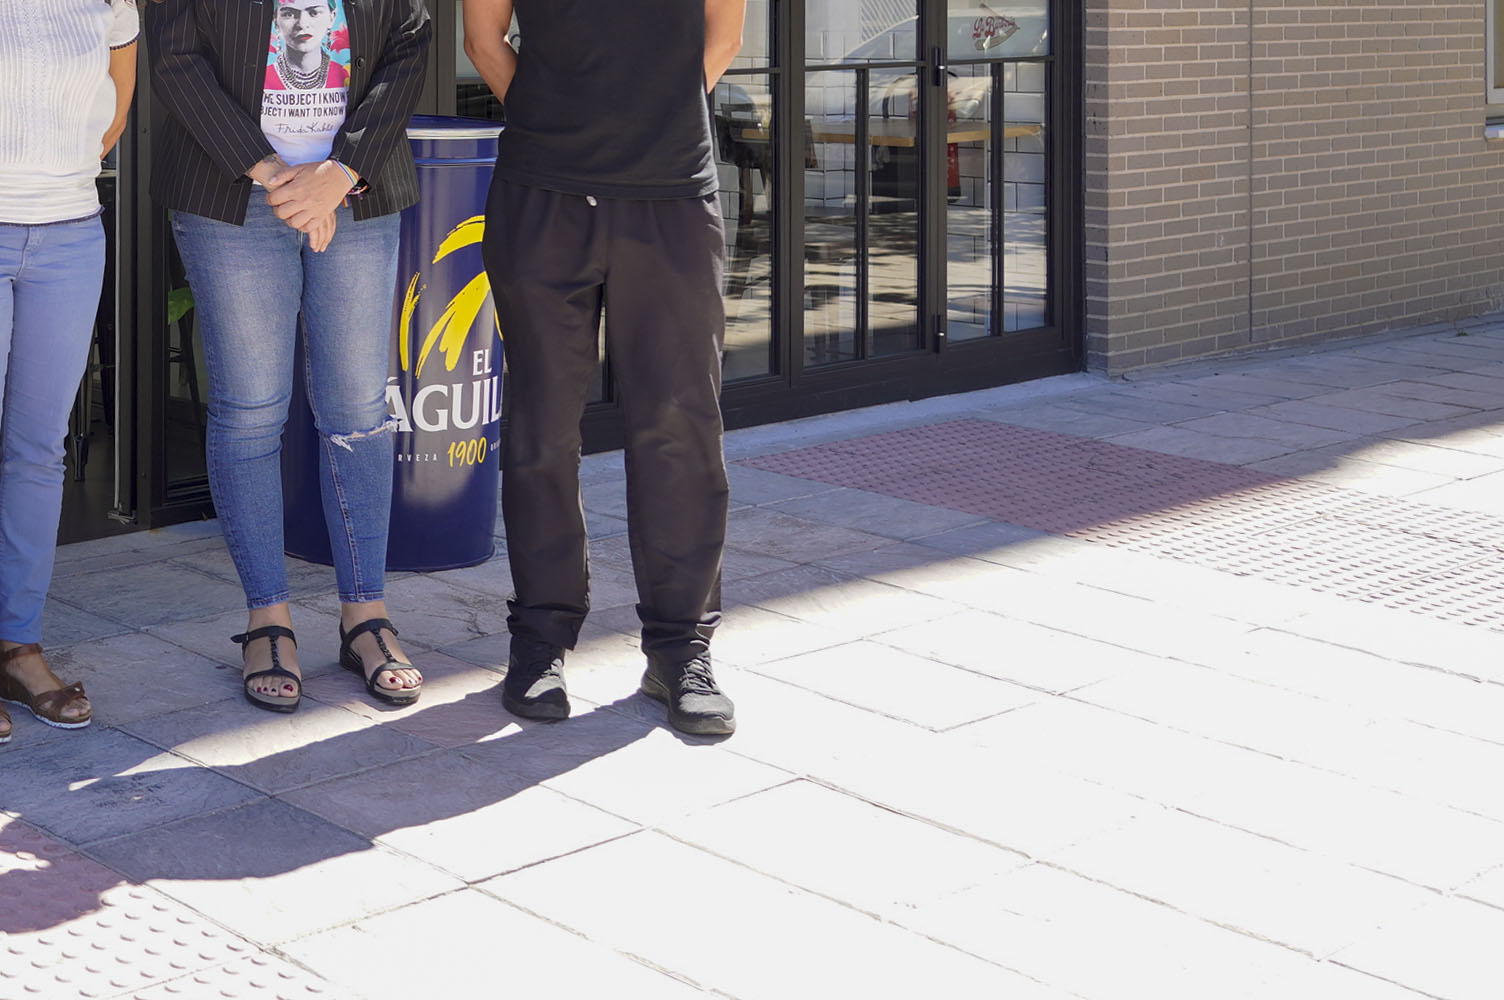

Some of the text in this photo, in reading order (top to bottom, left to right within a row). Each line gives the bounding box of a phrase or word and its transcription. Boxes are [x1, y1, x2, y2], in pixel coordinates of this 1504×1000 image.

[261, 105, 282, 118] BJECT
[288, 106, 311, 118] WANT
[313, 106, 322, 117] TO
[323, 104, 344, 117] KNOW
[276, 93, 317, 106] SUBJECT
[322, 91, 346, 104] KNOW
[473, 349, 493, 376] EL
[385, 376, 502, 433] ÁGUIL
[398, 453, 438, 462] RVEZA
[448, 437, 487, 467] 1900
